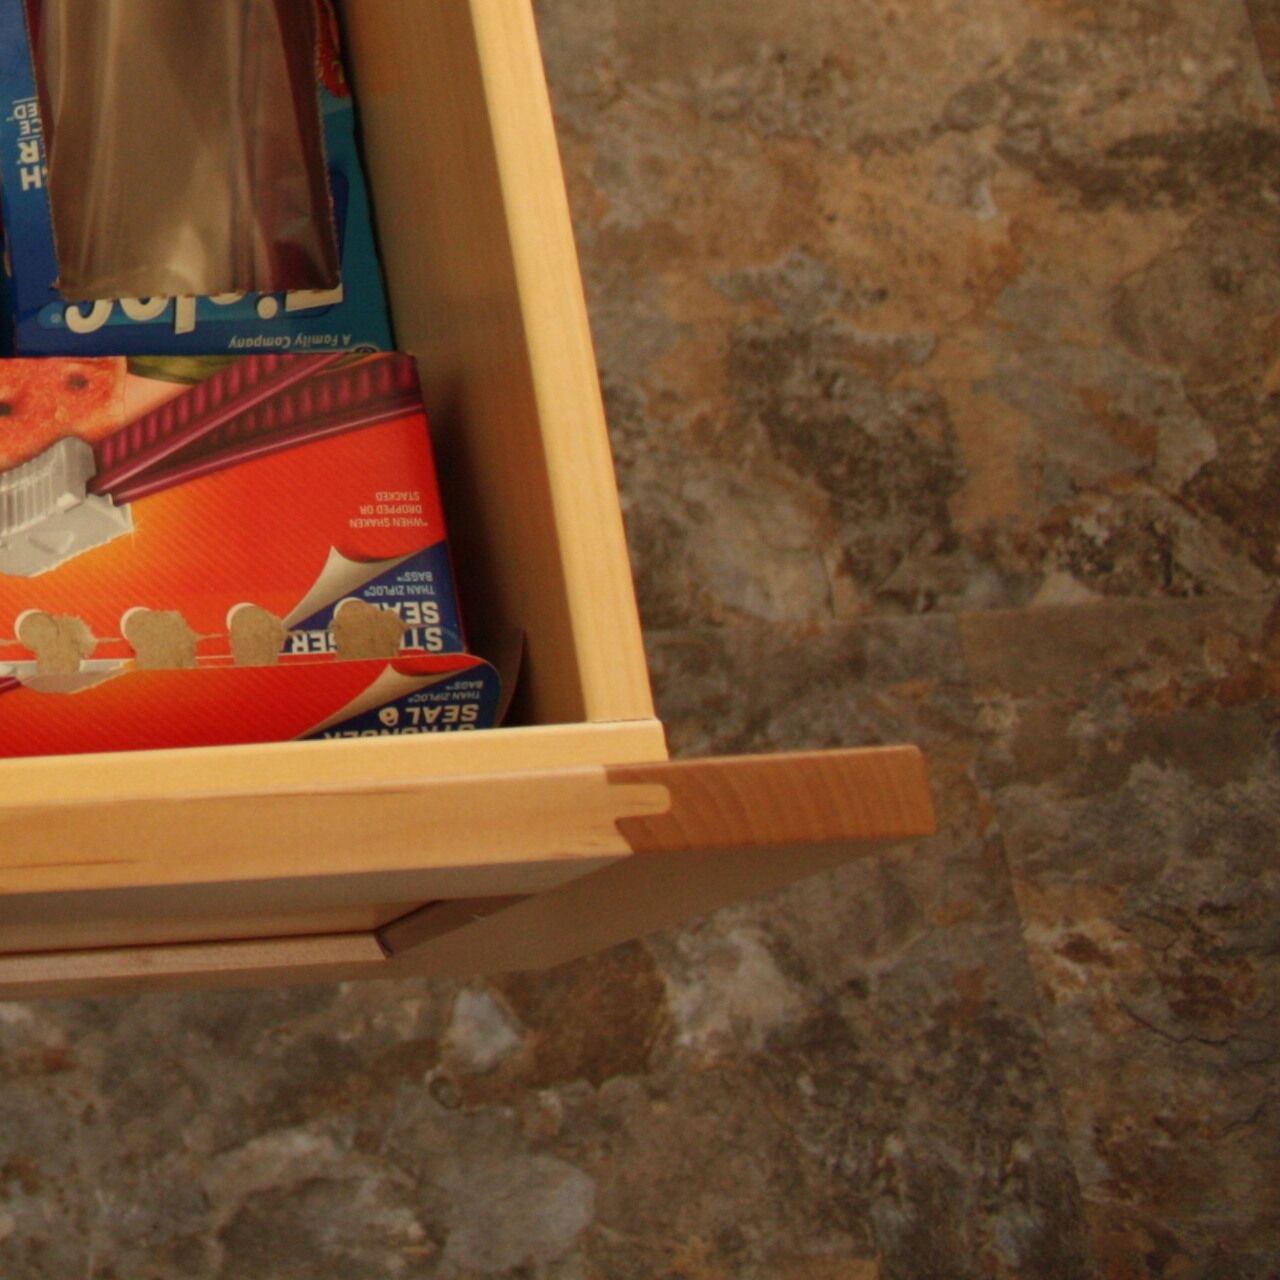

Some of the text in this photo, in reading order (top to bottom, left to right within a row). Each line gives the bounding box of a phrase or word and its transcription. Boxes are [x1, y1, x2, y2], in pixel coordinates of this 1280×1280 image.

[228, 333, 292, 351] Company
[295, 332, 340, 349] Family
[375, 490, 420, 502] STACKED
[359, 504, 423, 516] DROPPED OR
[349, 517, 390, 528] SHAKEN
[406, 584, 435, 596] THAN
[452, 690, 480, 700] THAN
[404, 703, 480, 725] SEAL
